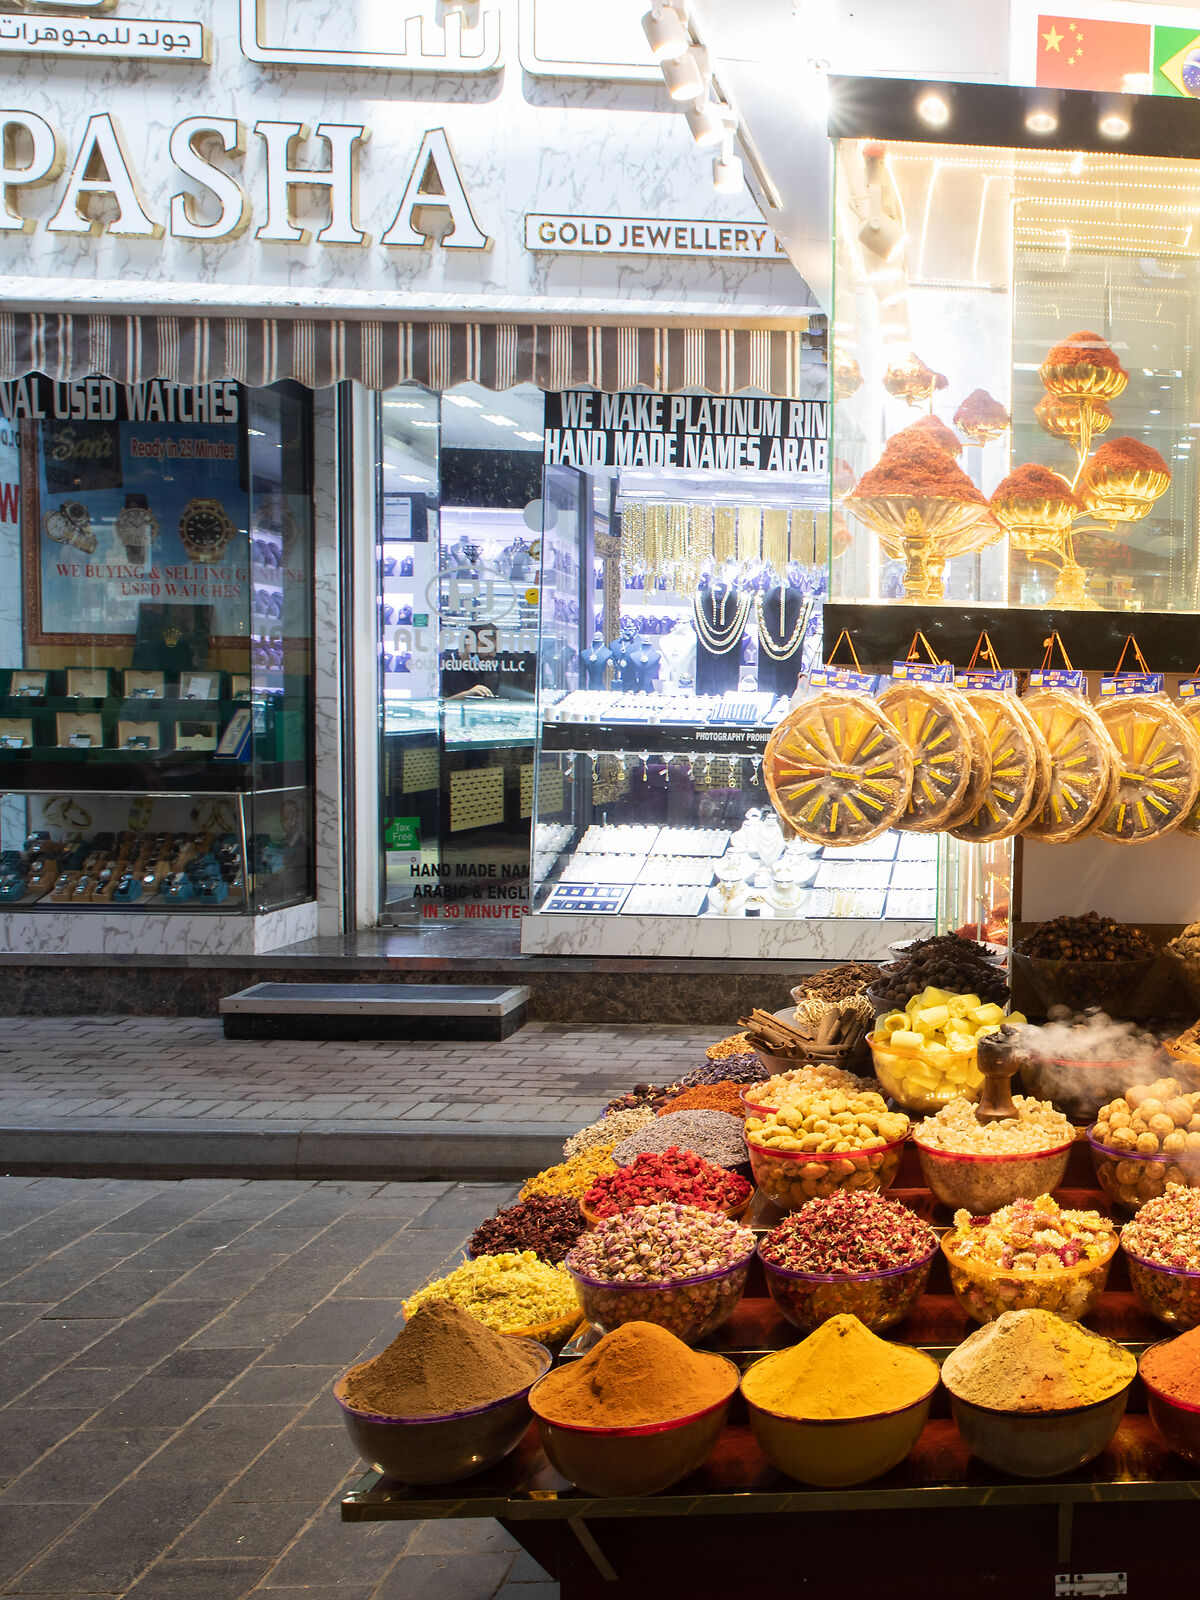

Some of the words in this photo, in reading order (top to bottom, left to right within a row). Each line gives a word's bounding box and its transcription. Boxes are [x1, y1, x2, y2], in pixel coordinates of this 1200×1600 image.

[137, 30, 190, 52] جولد
[0, 110, 492, 250] PASHA
[538, 221, 611, 246] GOLD
[619, 225, 767, 251] JEWELLERY
[53, 378, 116, 421] USED
[124, 380, 239, 423] WATCHES
[560, 391, 593, 429] WE
[600, 393, 664, 431] MAKE
[670, 396, 782, 437] PLATINUM
[131, 437, 164, 462] Ready
[167, 438, 178, 458] in
[179, 438, 193, 458] 25
[194, 439, 236, 460] Minutes
[545, 429, 608, 466] HAND
[614, 432, 677, 468] MADE
[684, 435, 760, 471] NAMES
[56, 564, 81, 577] WE
[86, 565, 144, 579] BUYING
[150, 566, 161, 578] &
[165, 566, 233, 581] SELLING
[121, 582, 161, 596] USED
[165, 583, 241, 598] WATCHES
[394, 629, 428, 652] AL
[440, 629, 537, 653] PASHA
[440, 659, 499, 671] JEWELLERY
[695, 732, 746, 741] PHOTOGRAPHY
[394, 823, 410, 832] Tax
[392, 833, 413, 841] Free
[410, 863, 450, 877] HAND
[456, 864, 496, 877] MADE
[413, 884, 467, 898] ARABIC
[473, 885, 483, 898] &
[422, 904, 437, 918] IN
[443, 905, 460, 918] 30
[464, 905, 529, 919] MINUTES
